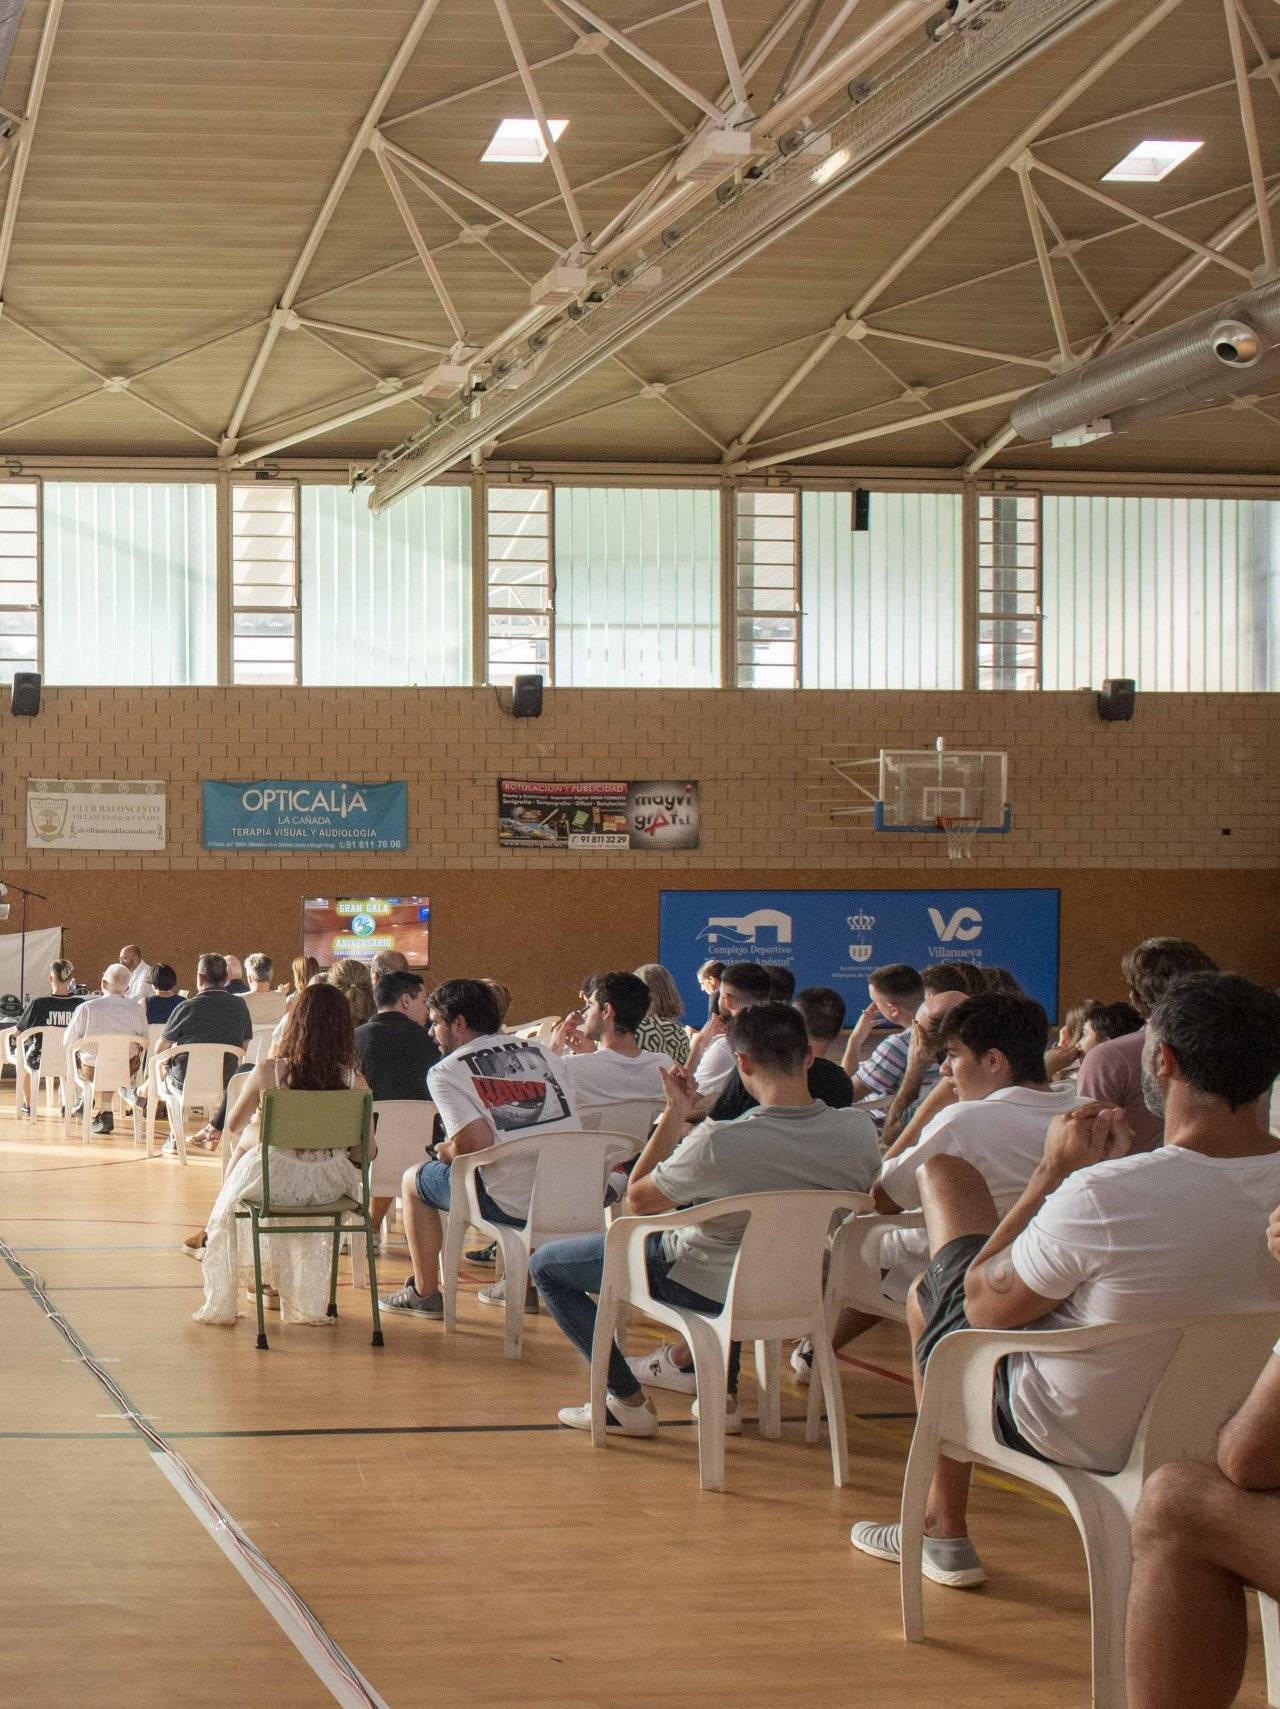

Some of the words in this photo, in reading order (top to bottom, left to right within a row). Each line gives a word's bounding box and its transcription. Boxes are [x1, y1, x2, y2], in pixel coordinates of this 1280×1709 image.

[570, 785, 623, 793] PUBLICIDAD
[278, 816, 290, 825] LA
[292, 814, 331, 825] CAÑADA
[232, 828, 271, 837] TERAPIA
[273, 828, 308, 837] VISUAL
[310, 828, 316, 837] Y
[319, 828, 377, 838] AUDIOLOGÍA
[339, 904, 362, 913] GRAN
[366, 904, 389, 913] GALA
[335, 938, 391, 948] ANIVERSARIO
[708, 945, 748, 956] Complejo
[750, 945, 792, 956] Deportivo
[928, 946, 983, 958] Villanueva
